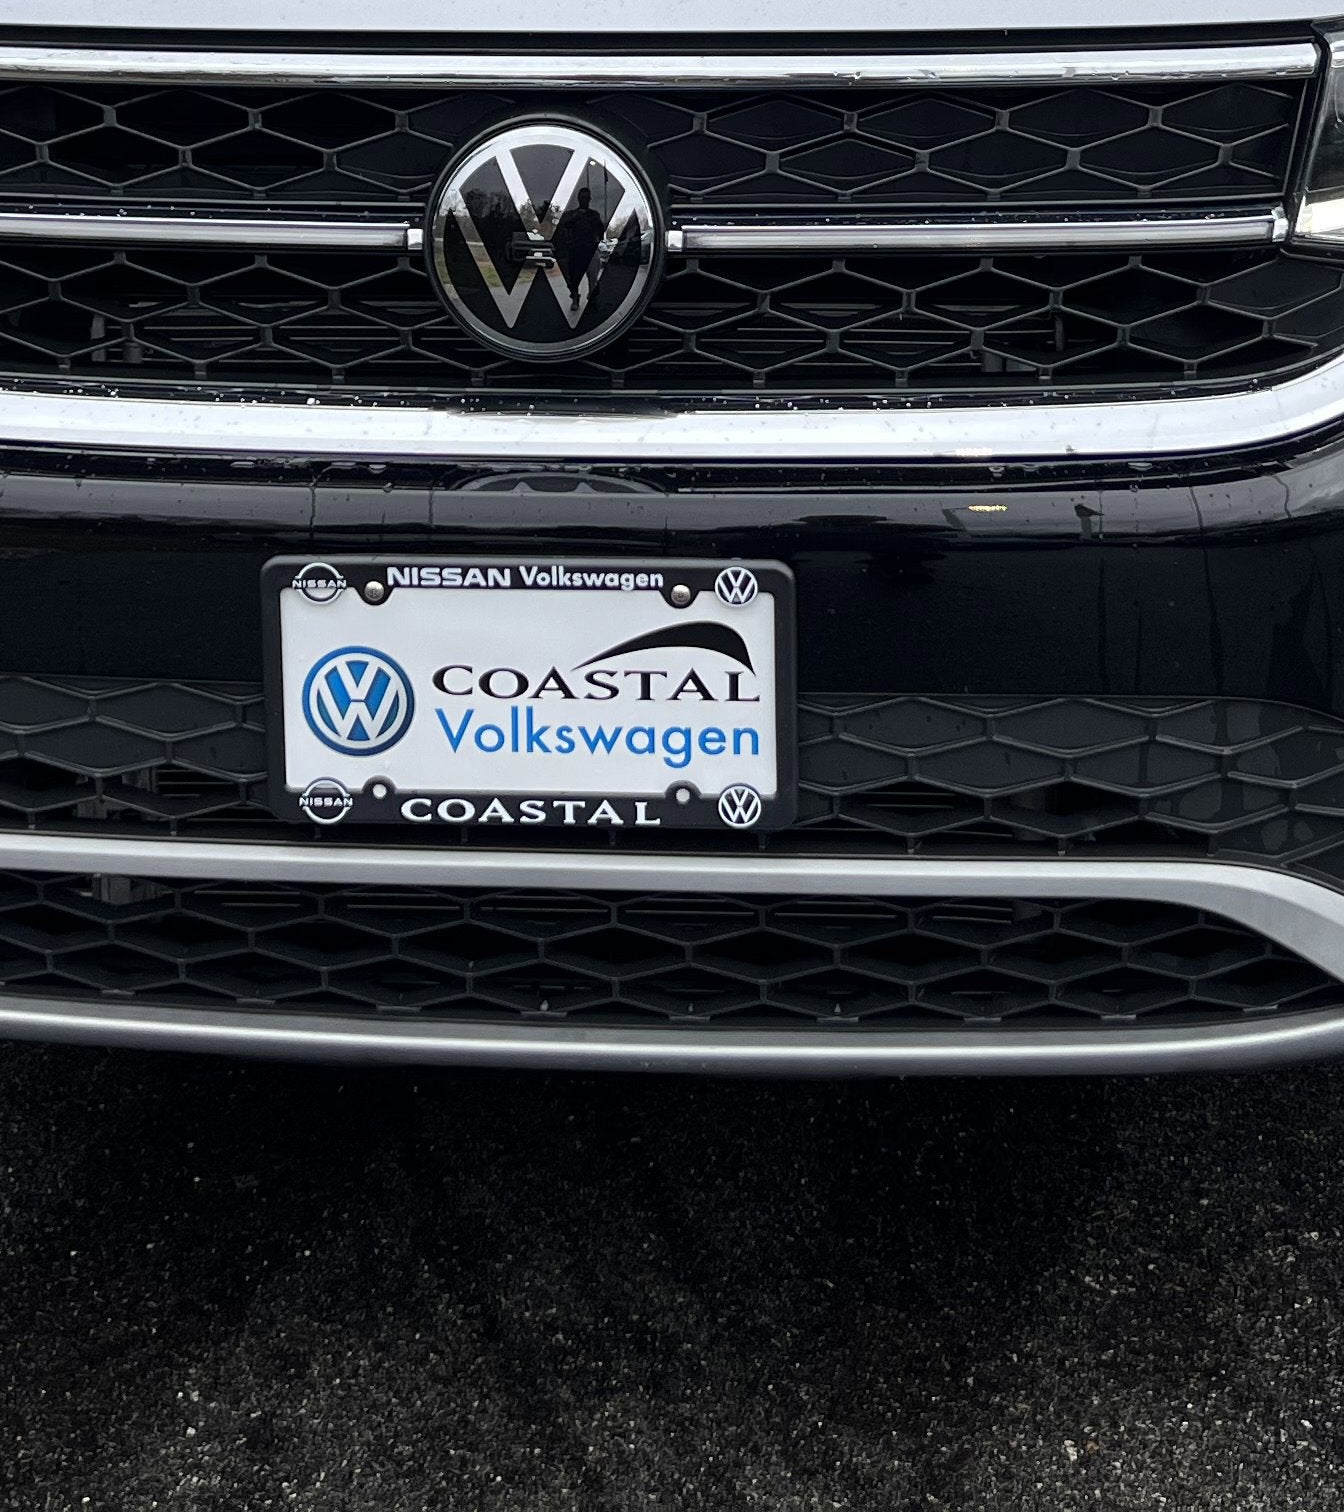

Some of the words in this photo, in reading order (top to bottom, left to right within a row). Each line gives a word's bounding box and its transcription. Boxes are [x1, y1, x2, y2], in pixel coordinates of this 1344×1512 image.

[292, 575, 347, 589] NISSAN
[387, 566, 511, 588] NISSAN
[519, 565, 665, 590] Volkswagen
[432, 664, 761, 702] COASTAL
[434, 705, 760, 769] Volkswagen
[299, 794, 353, 808] NISSAN
[401, 797, 661, 826] COASTAL
